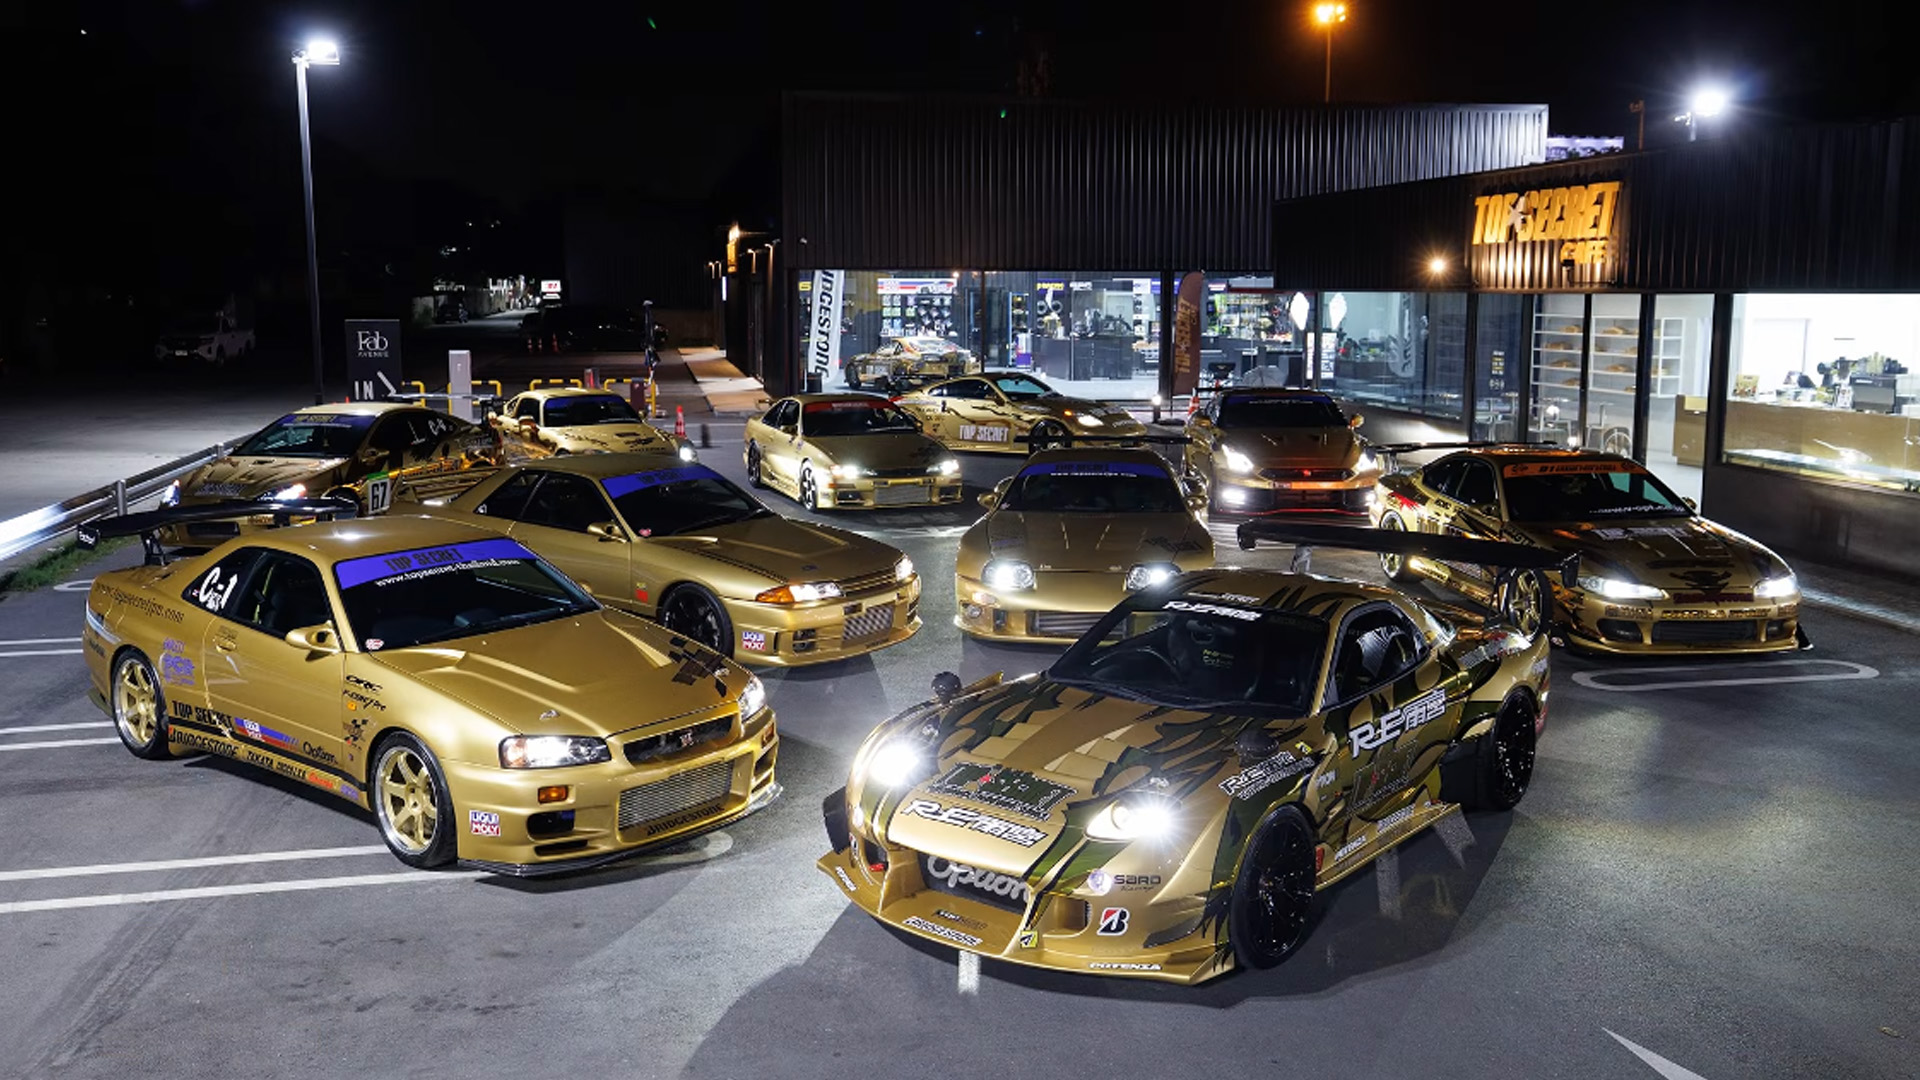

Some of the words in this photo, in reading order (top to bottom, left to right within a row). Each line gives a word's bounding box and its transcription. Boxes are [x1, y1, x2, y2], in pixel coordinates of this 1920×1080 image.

[1472, 193, 1519, 245] TOP
[1517, 181, 1620, 242] SECRET
[1560, 240, 1609, 265] CAFE
[357, 330, 389, 351] Fab
[354, 380, 375, 400] IN
[960, 425, 976, 440] TOP
[977, 426, 1009, 441] SECRET
[371, 482, 388, 511] 67
[384, 555, 413, 572] TOP
[413, 548, 465, 567] SECRET
[172, 700, 193, 718] TOP
[195, 706, 233, 729] SECRET
[471, 822, 501, 836] MOLY
